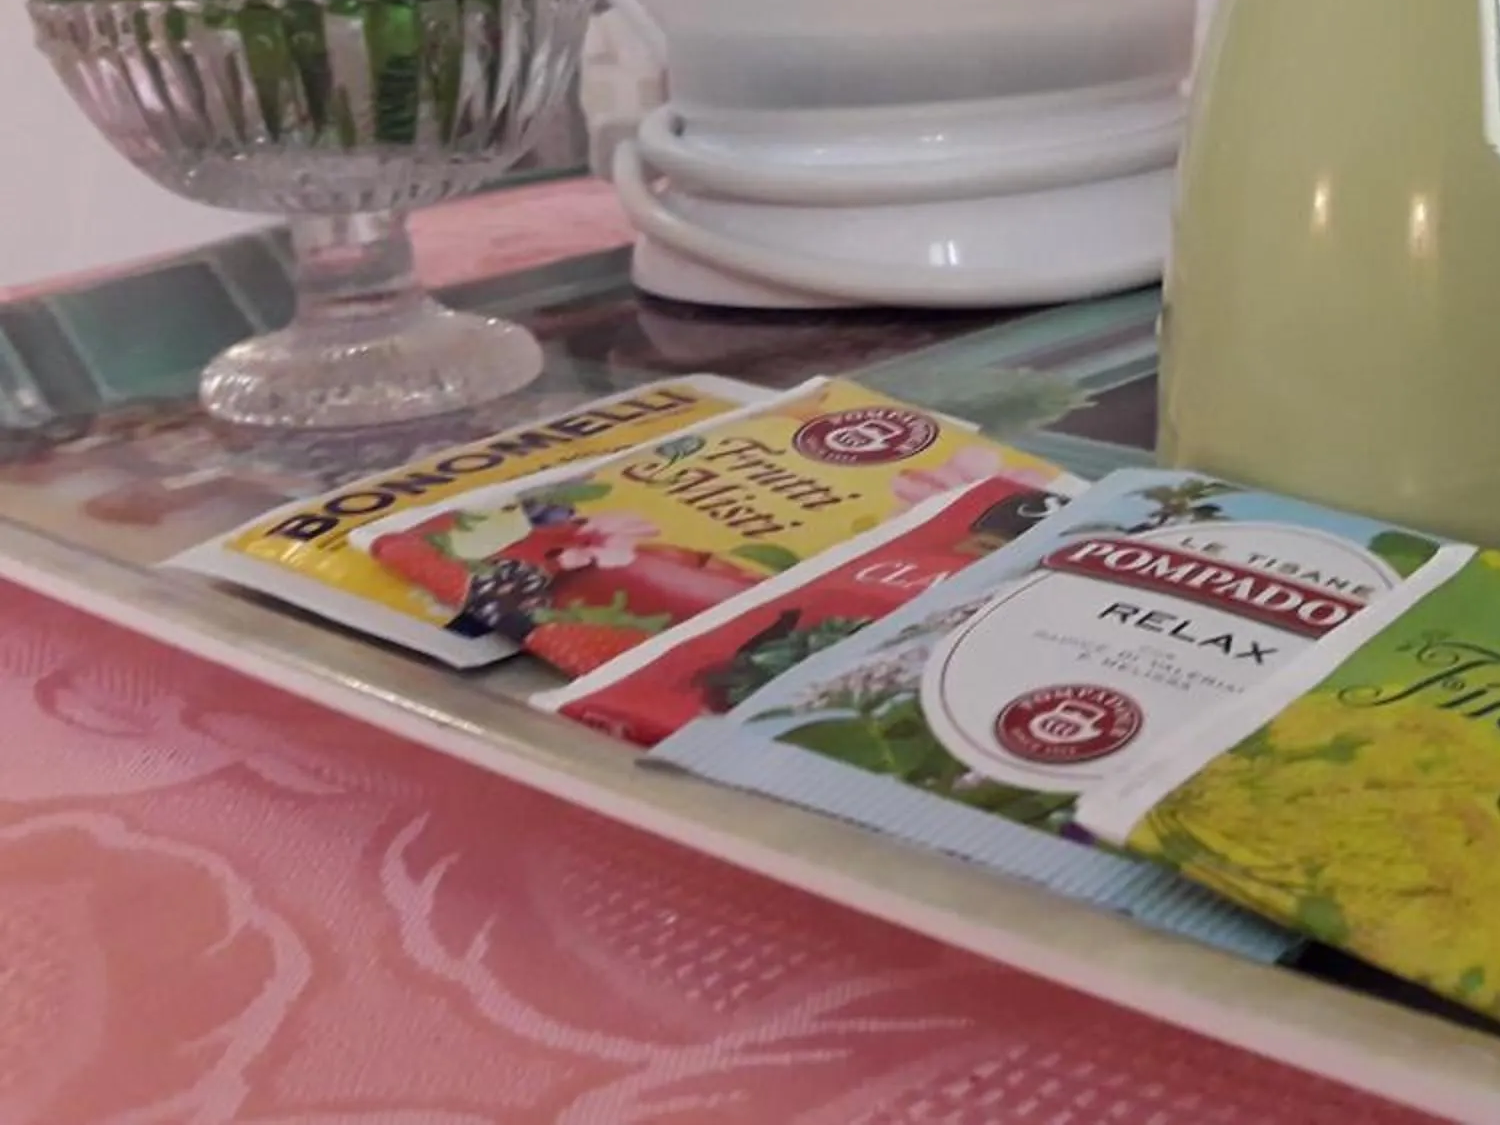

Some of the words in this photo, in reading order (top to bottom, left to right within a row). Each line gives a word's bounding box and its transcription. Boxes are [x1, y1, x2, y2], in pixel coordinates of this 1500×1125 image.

[264, 387, 698, 542] BONOMELLI
[622, 463, 803, 537] Misti
[704, 437, 861, 509] Frutti
[1068, 542, 1350, 627] POMPADO
[1181, 535, 1229, 555] LE
[1248, 552, 1376, 596] TISANE
[1098, 603, 1279, 665] RELAX
